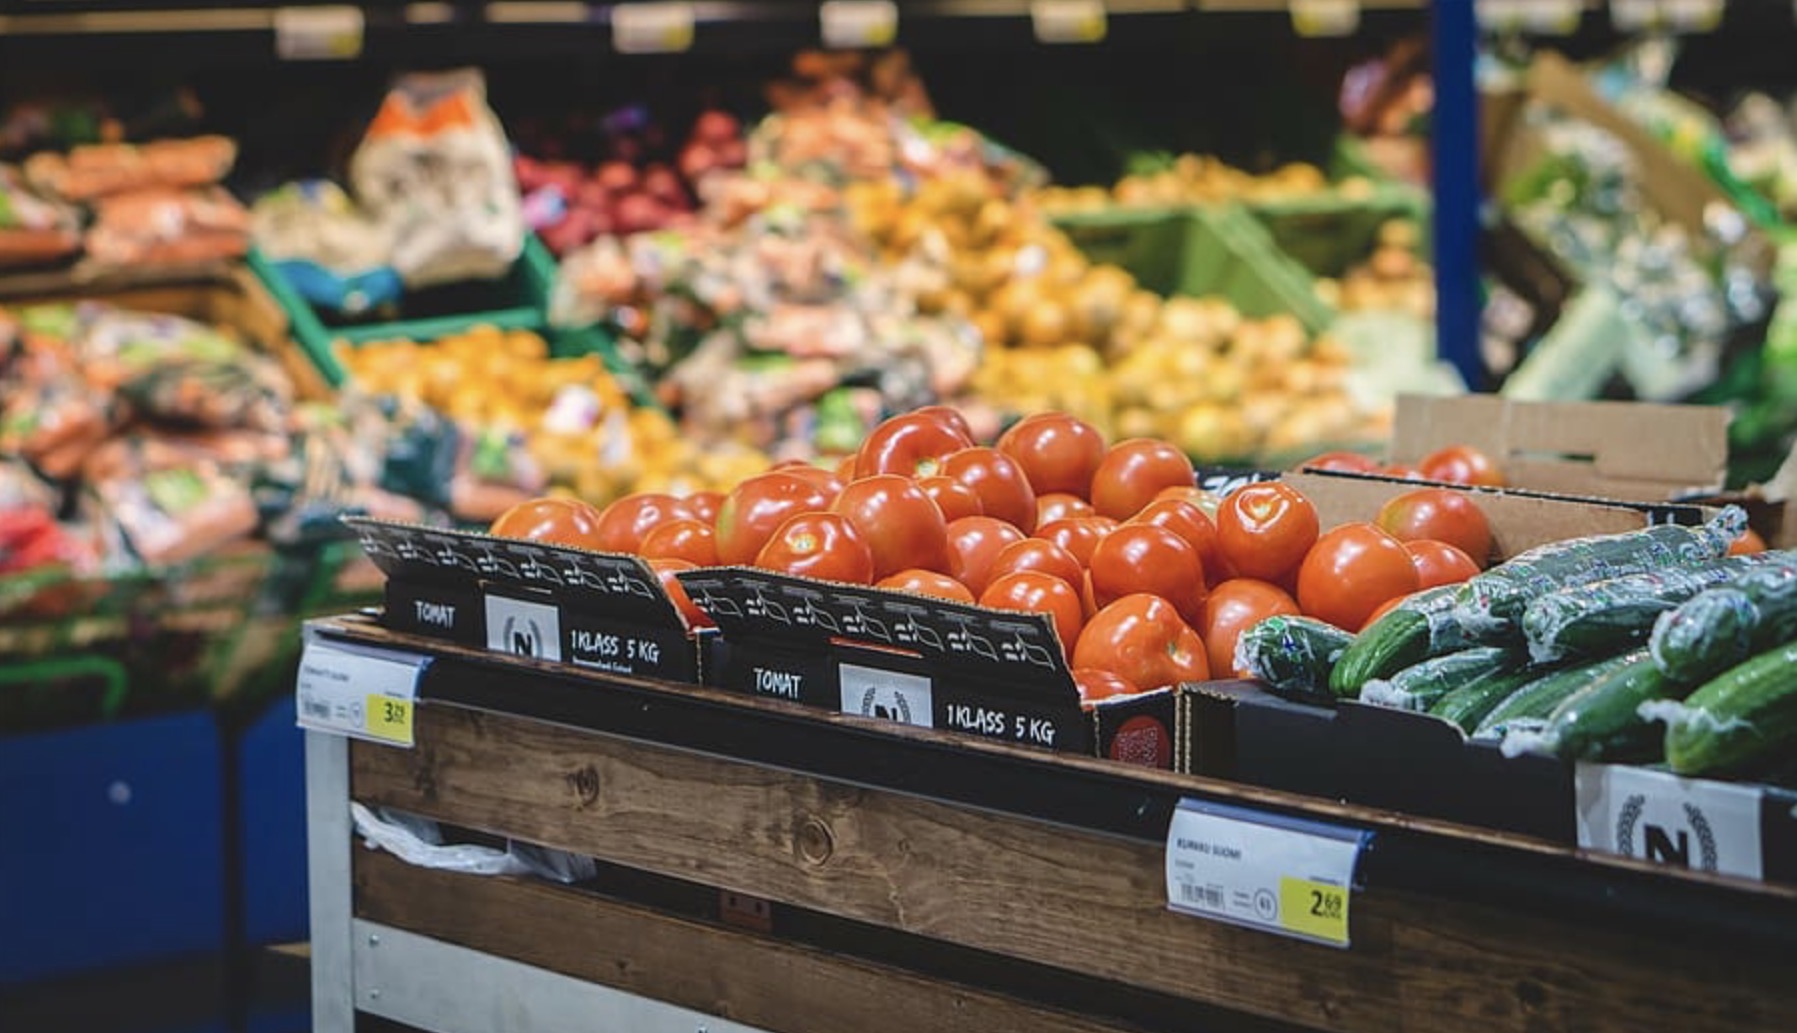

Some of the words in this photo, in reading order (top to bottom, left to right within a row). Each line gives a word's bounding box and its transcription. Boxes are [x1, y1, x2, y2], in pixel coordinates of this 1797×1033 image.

[414, 600, 455, 629] TOMAT
[513, 631, 533, 658] N
[578, 631, 619, 656] KLASS
[627, 639, 636, 659] 5
[638, 641, 660, 663] KG
[752, 667, 802, 699] TOMAT
[956, 706, 1006, 734] KLASS
[1015, 716, 1026, 739] 5
[1029, 719, 1056, 745] KG
[1643, 824, 1690, 869] N
